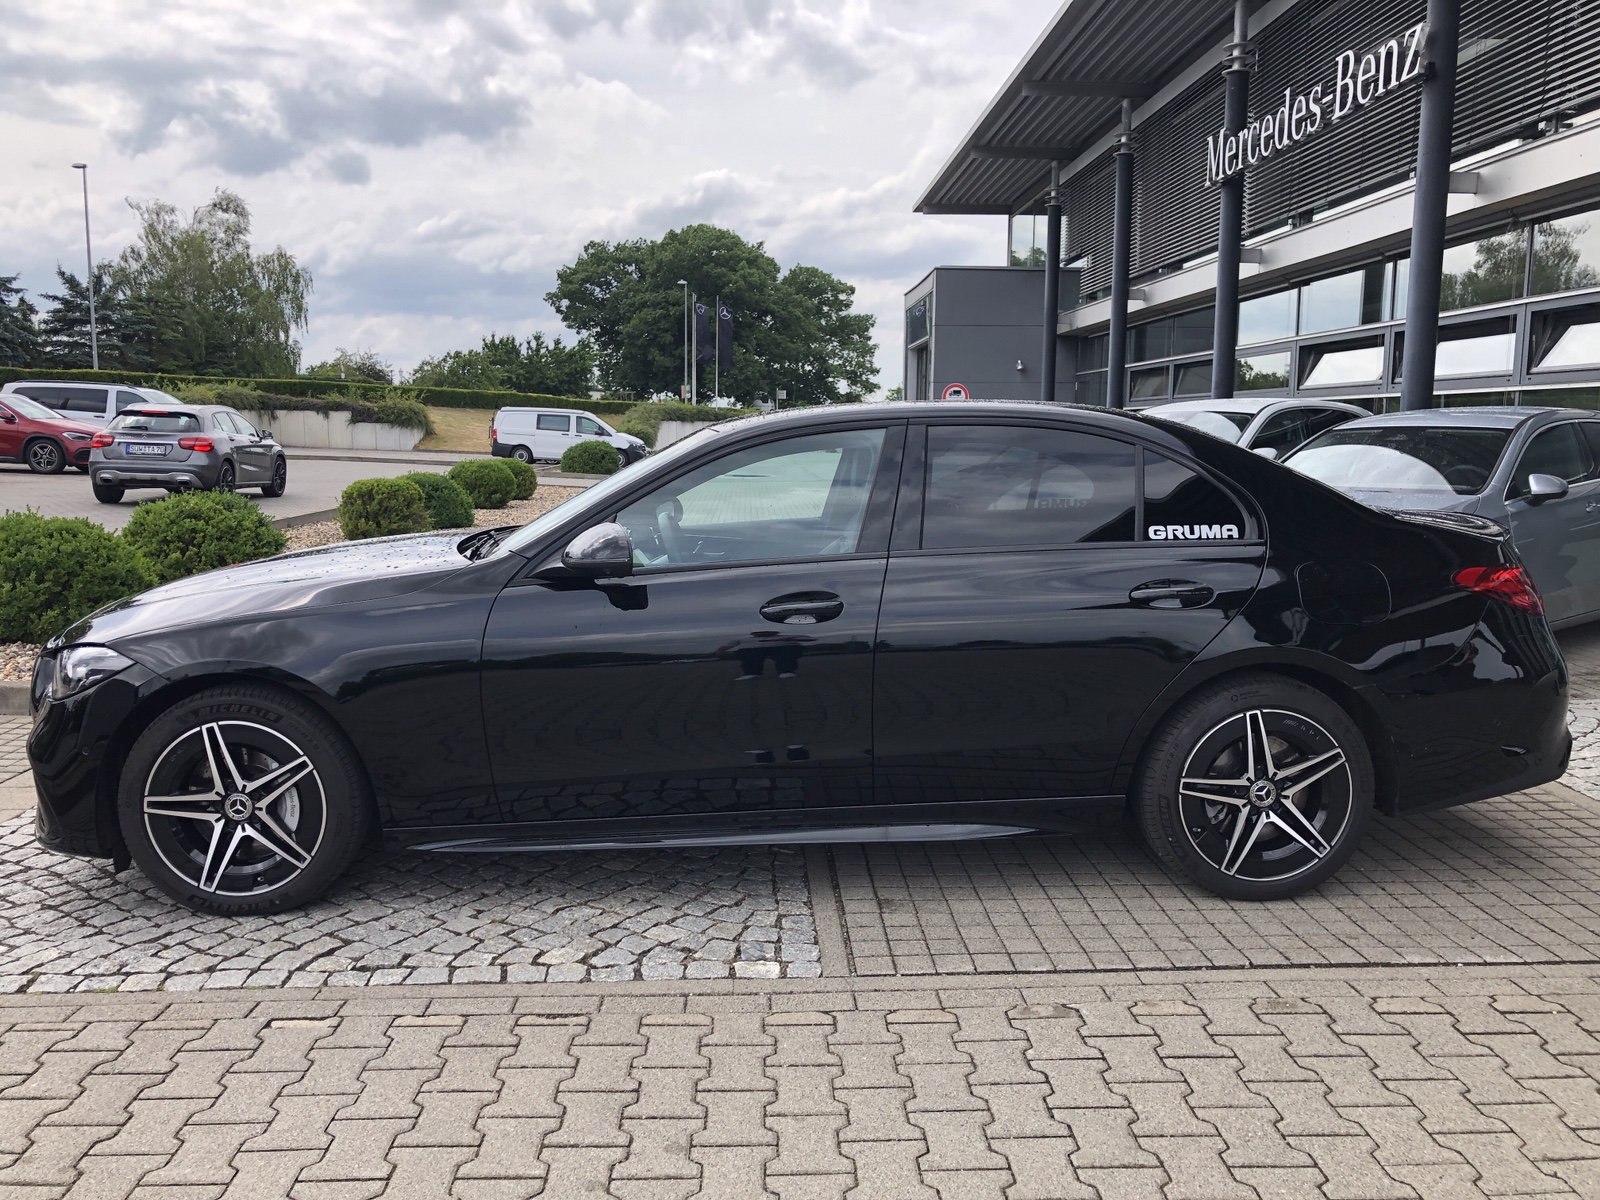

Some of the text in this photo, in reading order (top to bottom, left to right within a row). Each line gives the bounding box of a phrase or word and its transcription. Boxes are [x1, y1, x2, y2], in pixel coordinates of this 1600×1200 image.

[1204, 22, 1424, 187] Mercedes-Benz
[1148, 524, 1239, 540] GRUMA
[198, 704, 279, 720] MICHELIN
